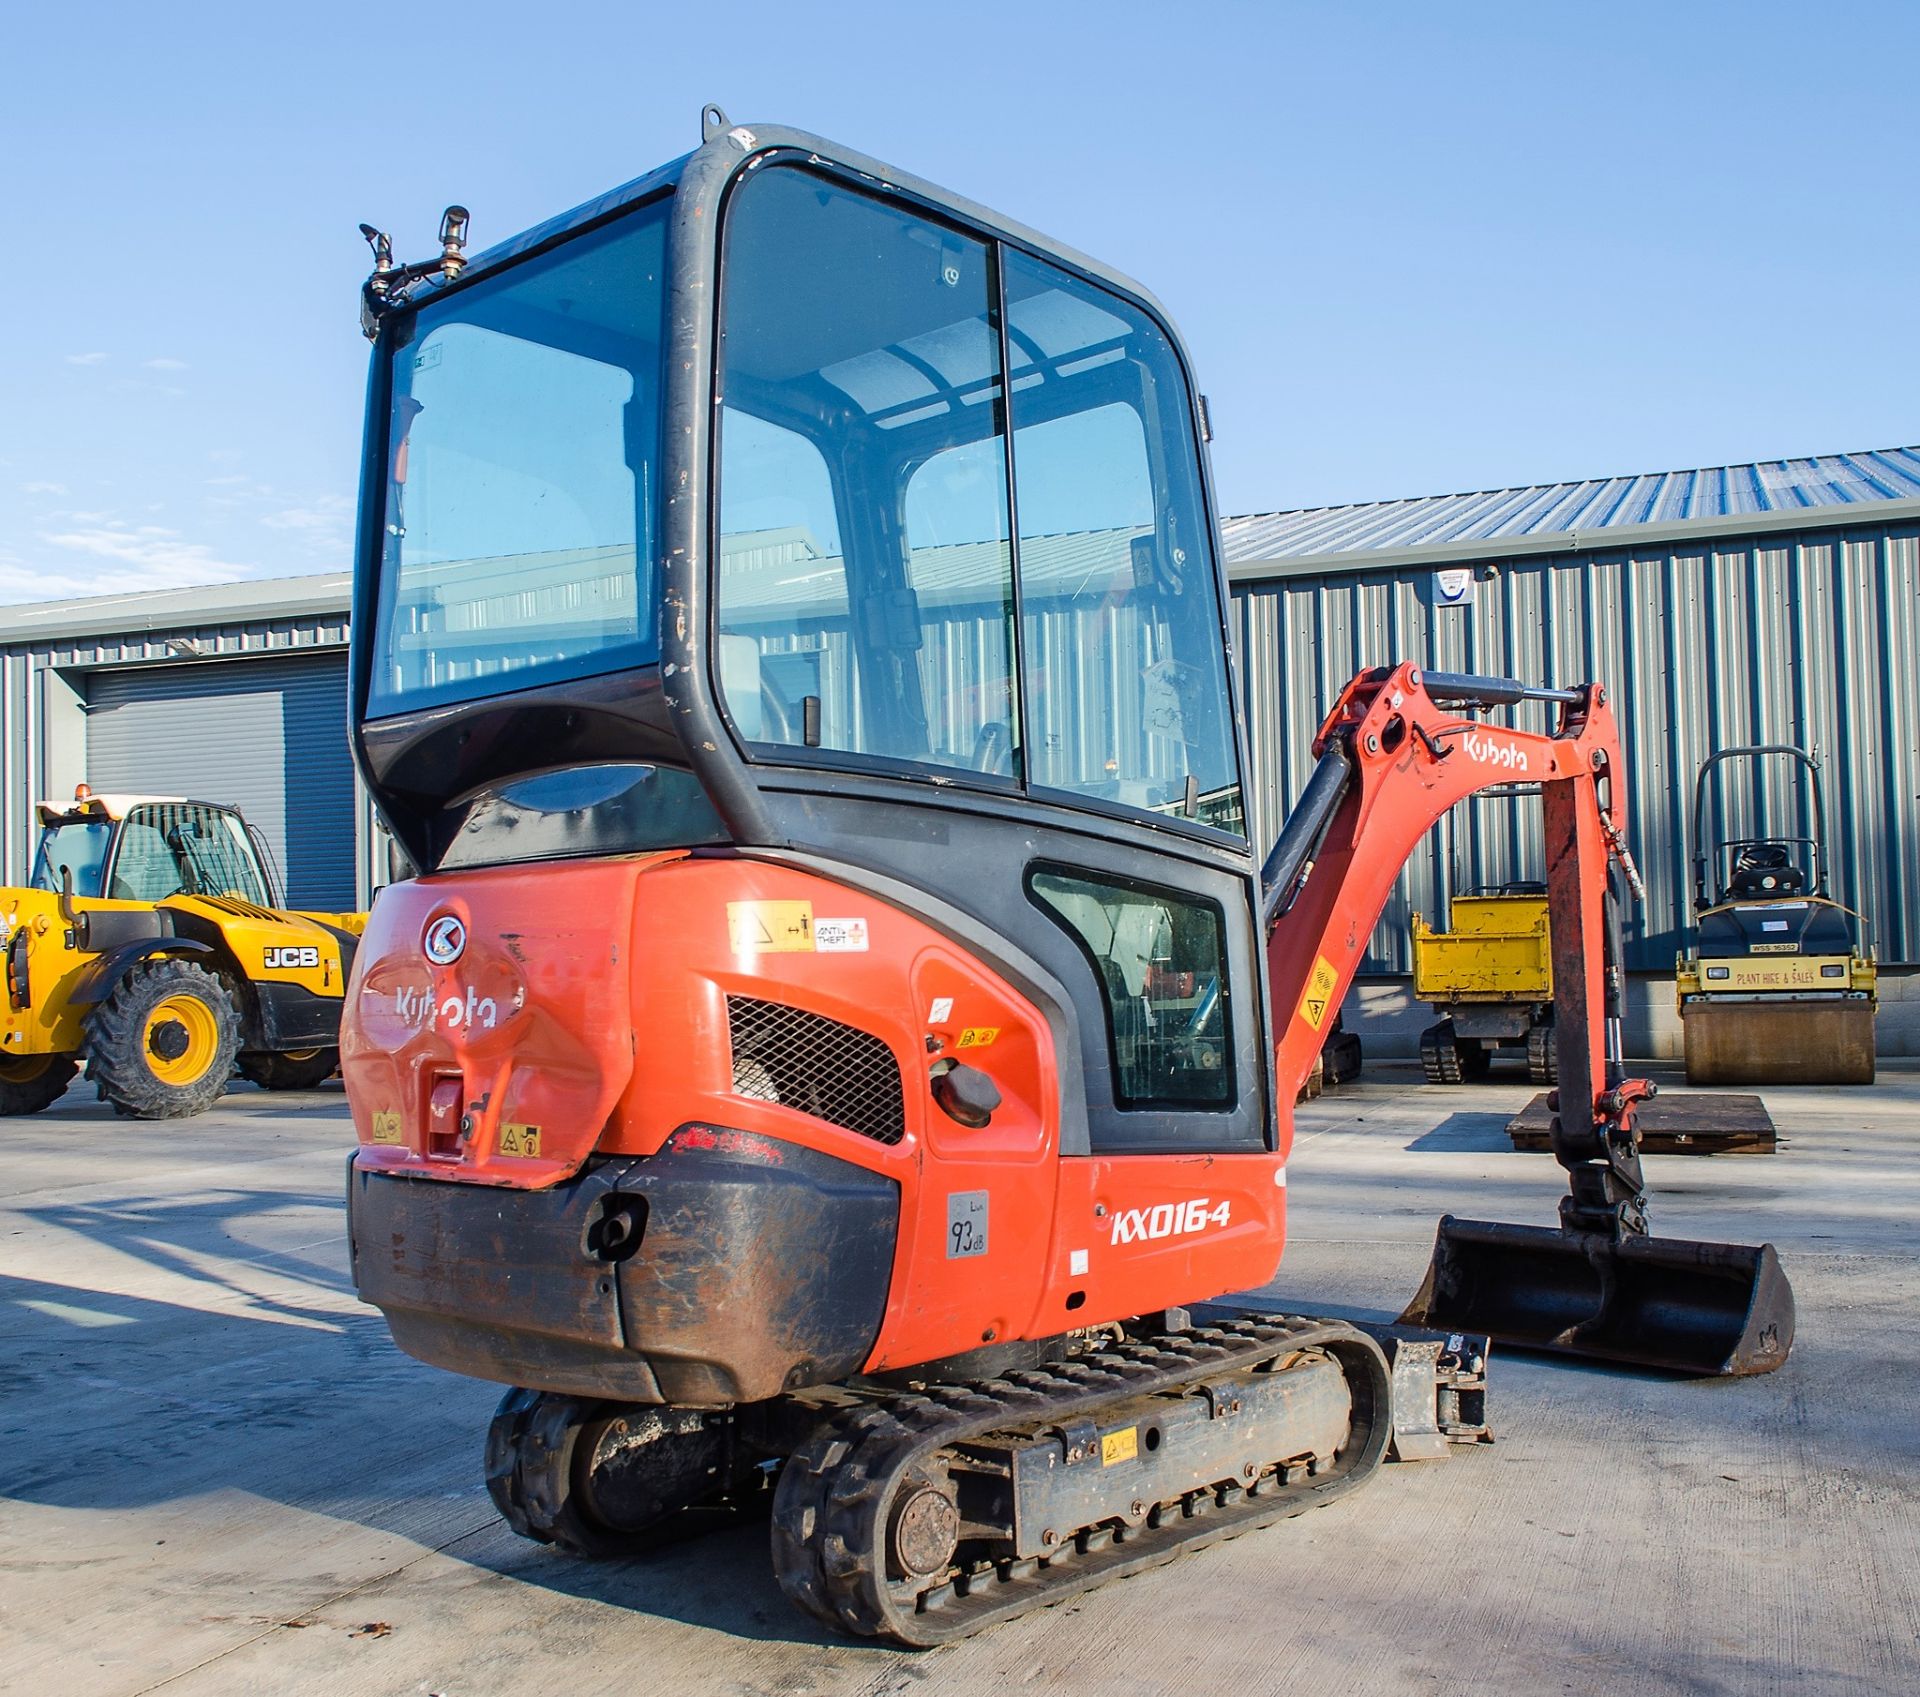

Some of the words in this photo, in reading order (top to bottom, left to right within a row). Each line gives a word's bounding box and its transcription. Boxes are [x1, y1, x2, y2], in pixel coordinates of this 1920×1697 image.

[1463, 732, 1528, 772] Kubota
[264, 947, 319, 968] JCB
[1736, 973, 1760, 985] PLANT
[1792, 972, 1815, 984] SALES
[395, 985, 497, 1031] Kubota
[952, 1220, 972, 1253] 93
[1110, 1198, 1231, 1246] KX016-4
